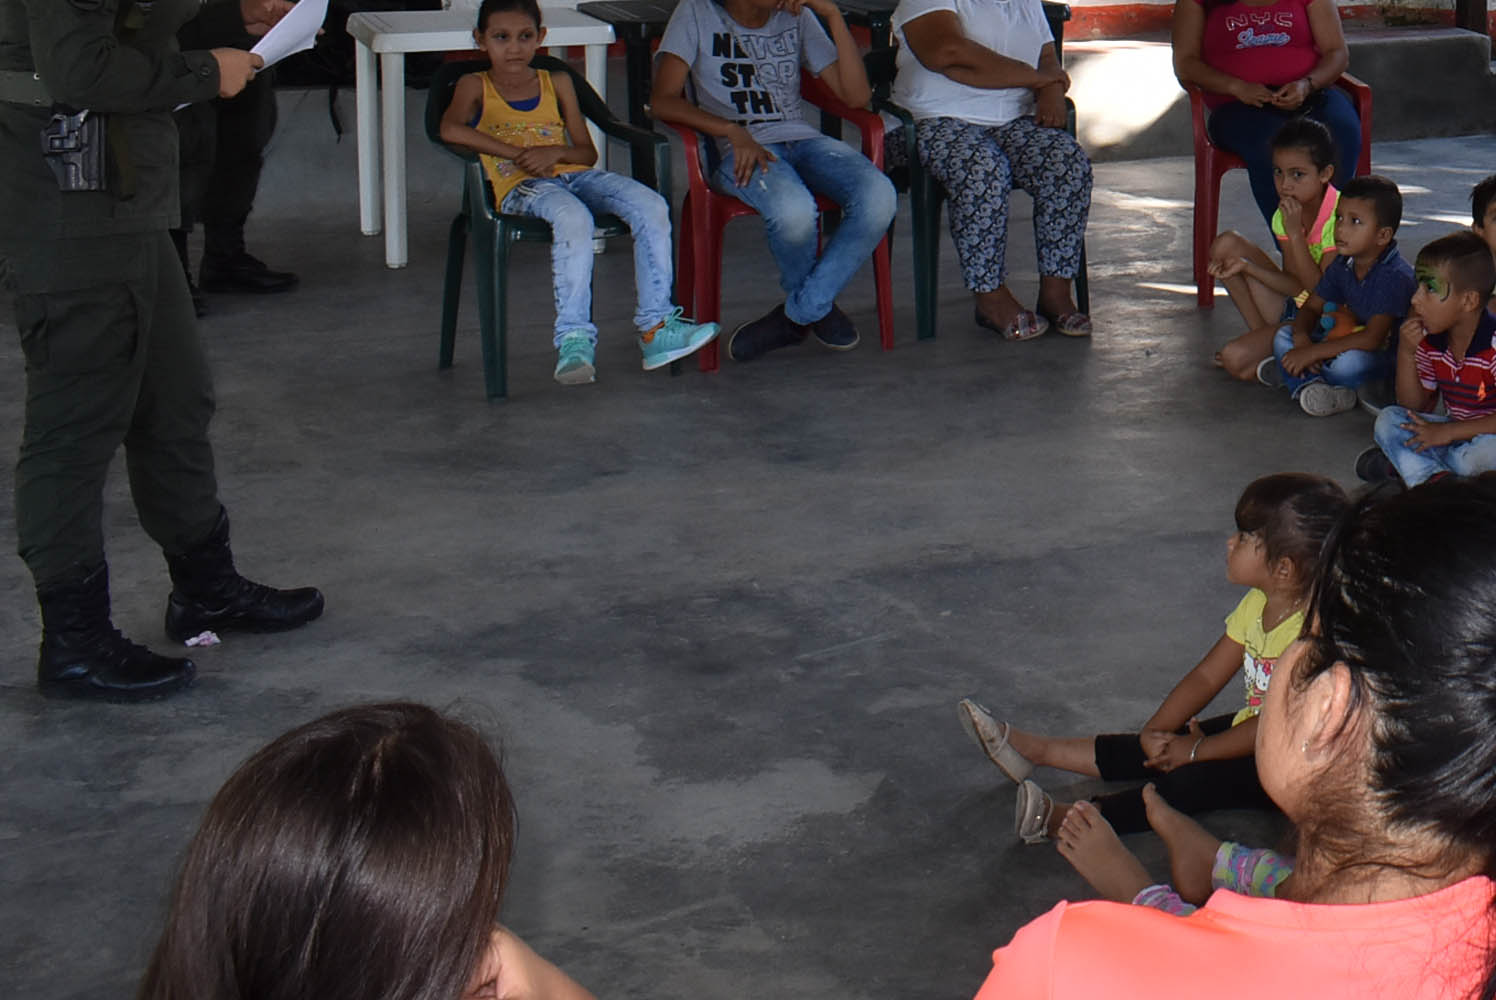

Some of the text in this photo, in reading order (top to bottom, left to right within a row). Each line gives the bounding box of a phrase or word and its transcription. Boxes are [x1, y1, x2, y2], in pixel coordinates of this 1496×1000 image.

[1225, 11, 1293, 31] NYC
[712, 27, 798, 60] NEVER
[720, 60, 796, 88] STOP
